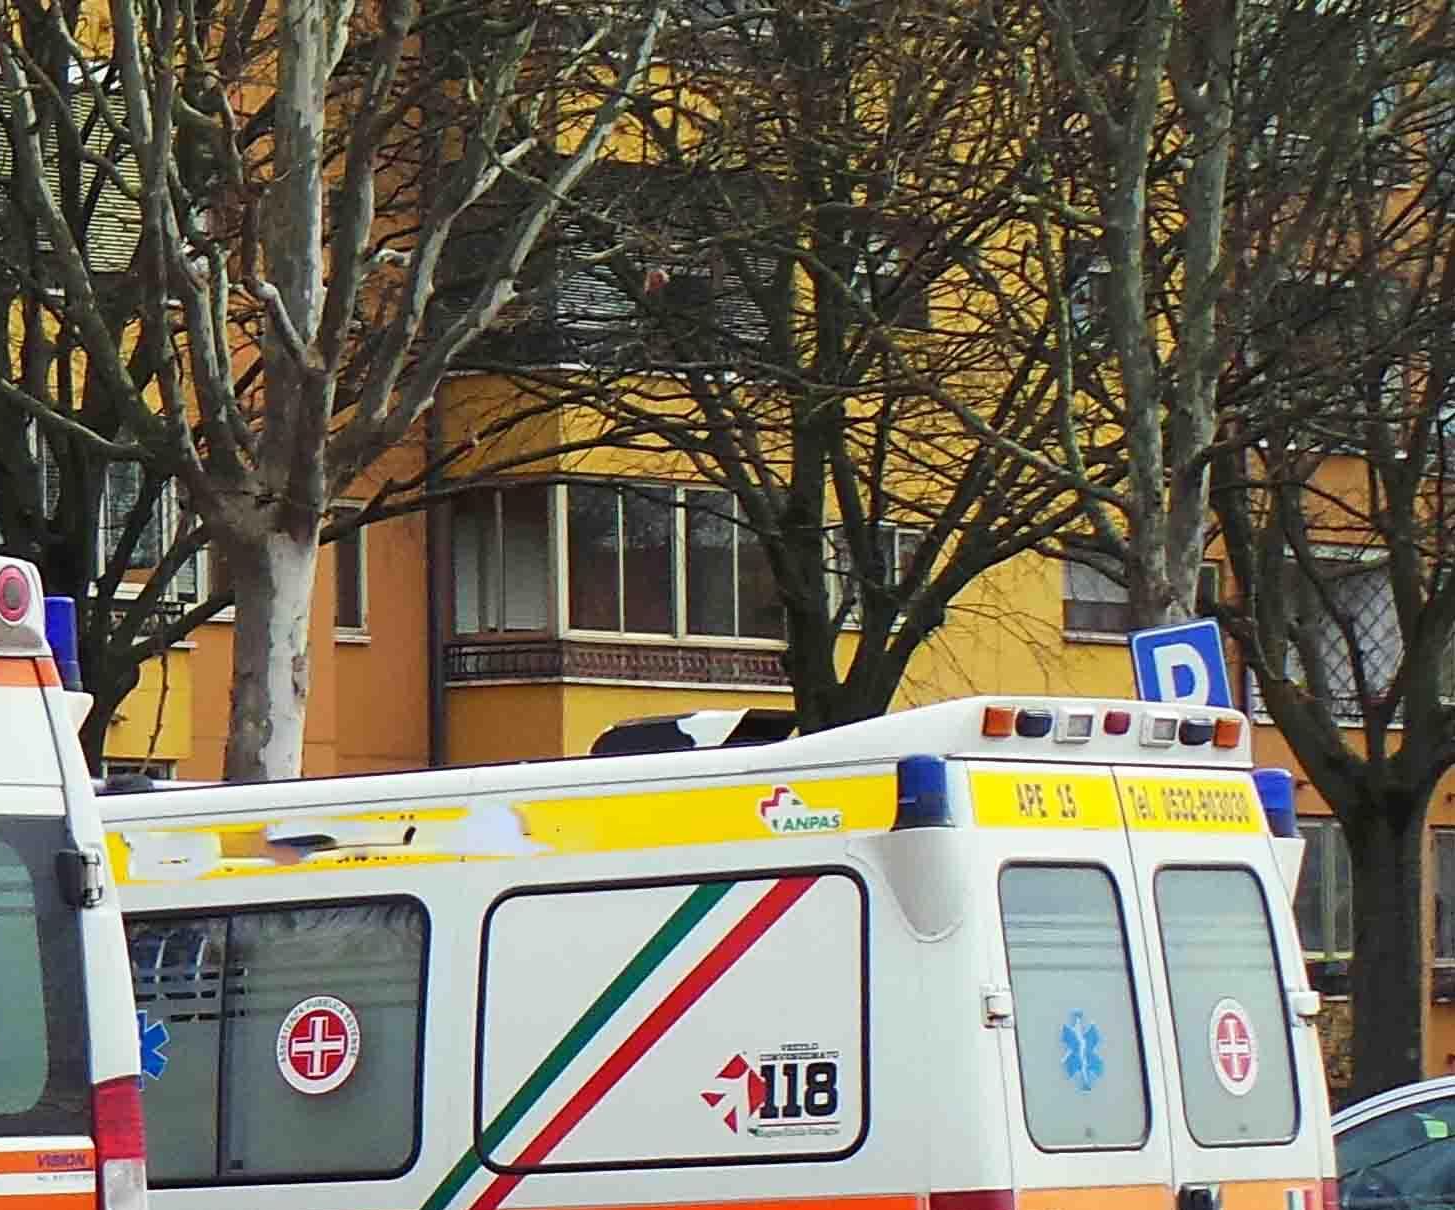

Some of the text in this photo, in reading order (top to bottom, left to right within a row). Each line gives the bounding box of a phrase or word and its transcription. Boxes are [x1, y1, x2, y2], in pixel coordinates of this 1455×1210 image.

[1015, 783, 1077, 818] APE 15
[783, 814, 841, 830] ANPAS
[759, 1061, 839, 1119] 118
